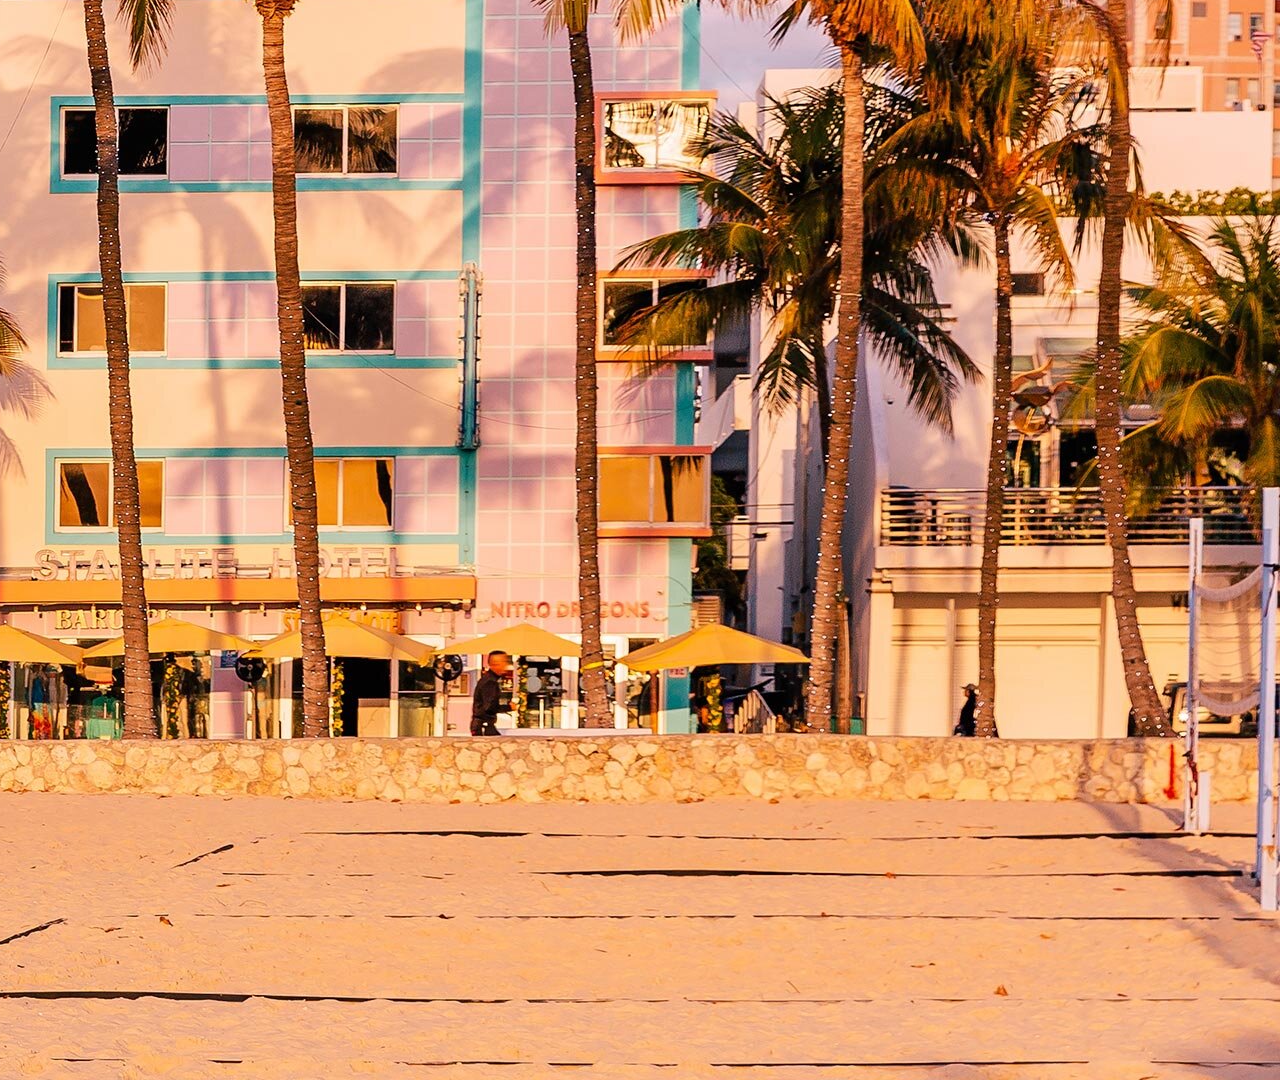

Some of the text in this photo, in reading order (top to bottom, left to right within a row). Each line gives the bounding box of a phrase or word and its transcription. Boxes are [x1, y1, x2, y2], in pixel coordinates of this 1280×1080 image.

[34, 548, 236, 581] STALITE
[491, 601, 650, 618] NITRO DRGONS
